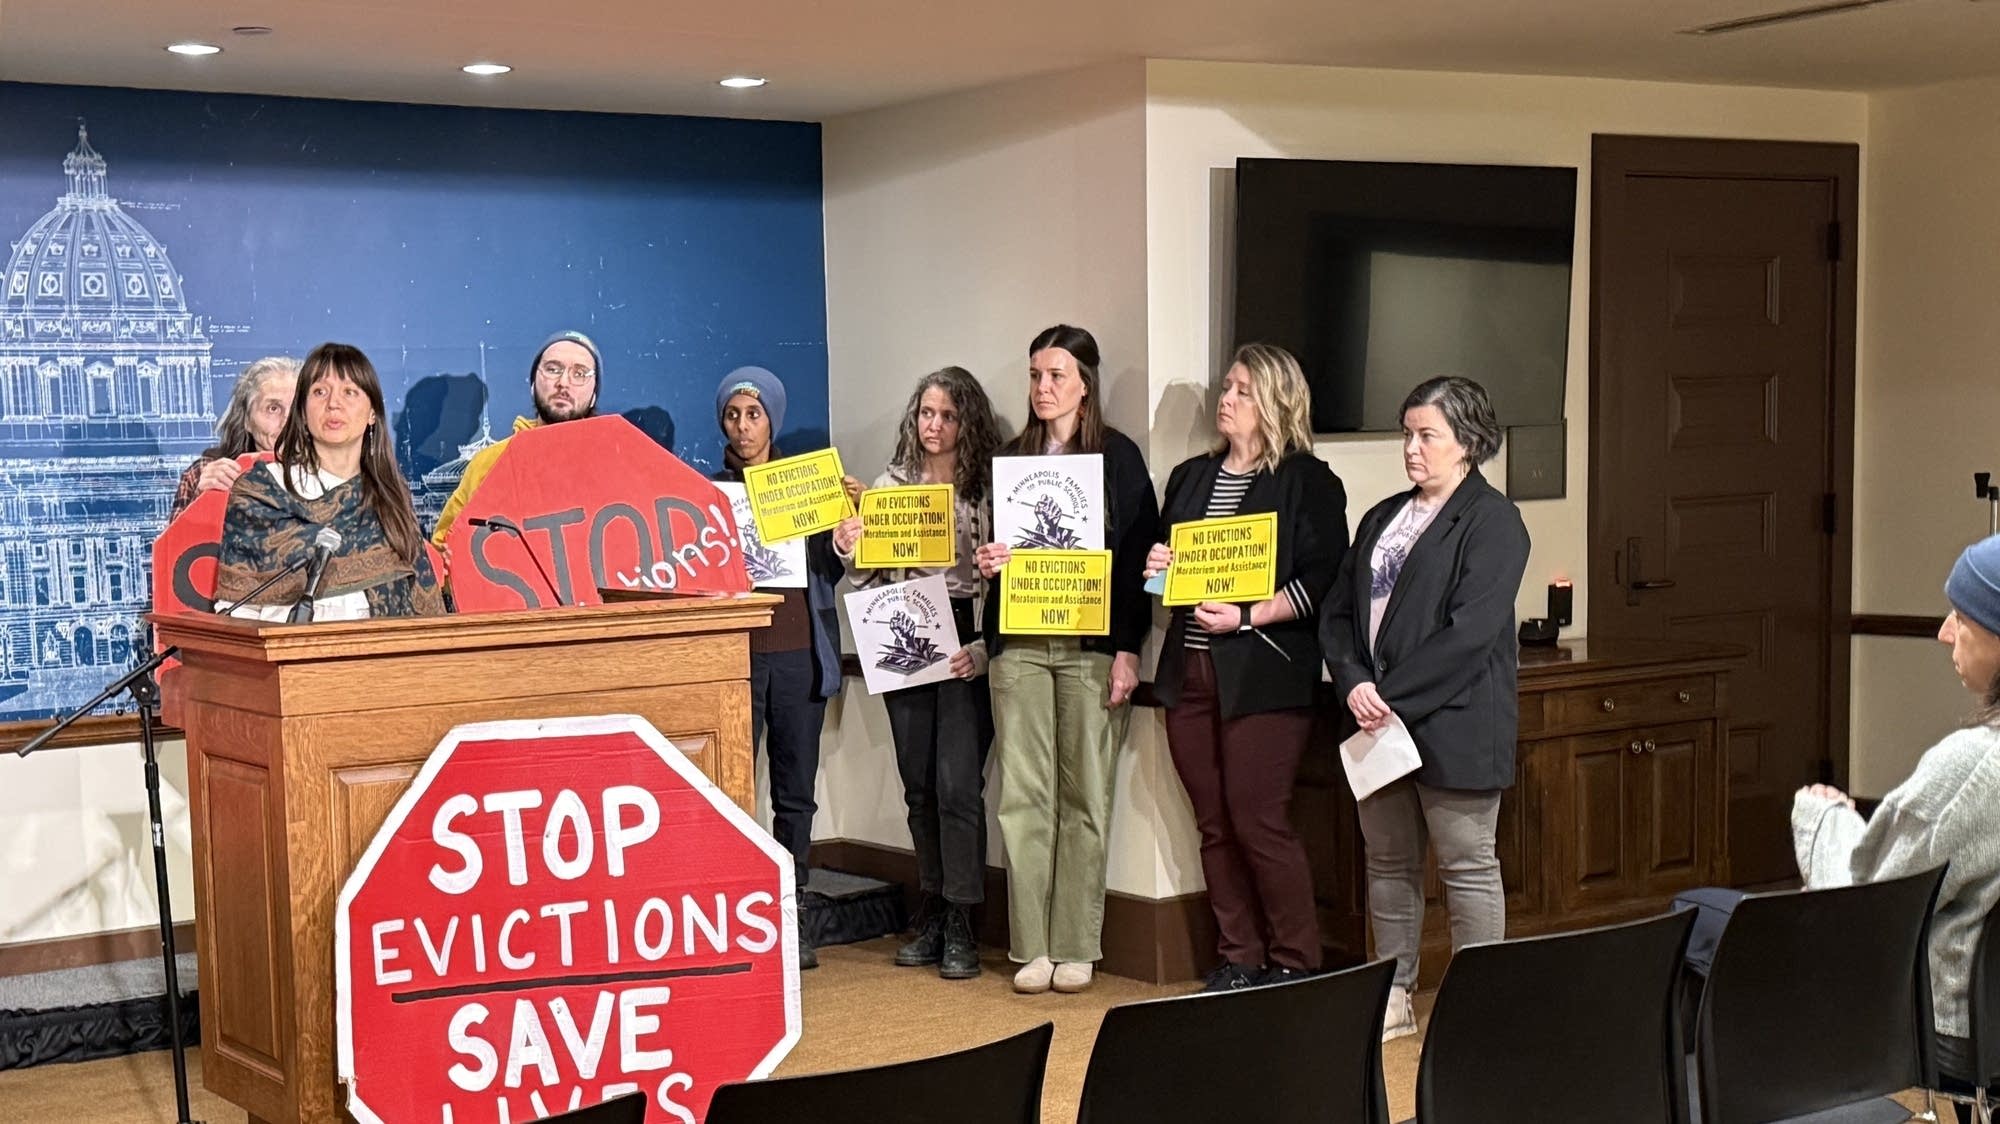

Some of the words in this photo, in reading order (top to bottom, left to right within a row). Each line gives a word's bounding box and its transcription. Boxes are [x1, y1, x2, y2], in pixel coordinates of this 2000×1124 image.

[766, 472, 778, 486] NO
[779, 463, 820, 483] EVICTIONS
[758, 488, 787, 505] UNDER
[786, 475, 838, 498] OCCUPATION!
[1012, 470, 1060, 495] MINNEAPOLIS
[1064, 476, 1089, 509] FAMILIES
[1037, 479, 1063, 488] PUBLIC
[1063, 485, 1080, 515] SCHOOLS
[761, 502, 797, 516] Moratorium
[797, 499, 808, 509] and
[809, 490, 843, 505] Assistance
[876, 497, 887, 510] NO
[889, 495, 930, 509] EVICTIONS
[792, 509, 820, 529] NOW!
[863, 513, 890, 526] UNDER
[892, 511, 946, 526] OCCUPATION!
[863, 529, 899, 539] Moratorium
[900, 529, 912, 538] and
[912, 528, 947, 538] Assistance
[1192, 531, 1205, 545] NO
[1207, 526, 1252, 544] EVICTIONS
[470, 496, 707, 608] STOP
[892, 542, 919, 558] NOW!
[1178, 549, 1207, 564] UNDER
[1209, 543, 1267, 561] OCCUPATION!
[1025, 560, 1038, 574] NO
[1040, 560, 1086, 574] EVICTIONS
[1176, 565, 1216, 575] Moratorium
[1216, 563, 1230, 574] and
[1230, 561, 1267, 572] Assistance
[1011, 577, 1040, 591] UNDER
[1043, 578, 1102, 592] OCCUPATION!
[1205, 577, 1235, 594] NOW!
[865, 587, 906, 616] MINNEAPOLIS
[912, 589, 938, 618] FAMILIES
[1010, 593, 1049, 604] Moratorium
[1050, 595, 1063, 604] and
[1064, 594, 1102, 605] Assistance
[887, 595, 911, 604] PUBLIC
[913, 599, 933, 624] SCHOOLS
[1041, 609, 1070, 625] NOW!
[428, 785, 661, 894] STOP
[372, 891, 778, 985] EVICTIONS
[447, 986, 673, 1092] SAVE
